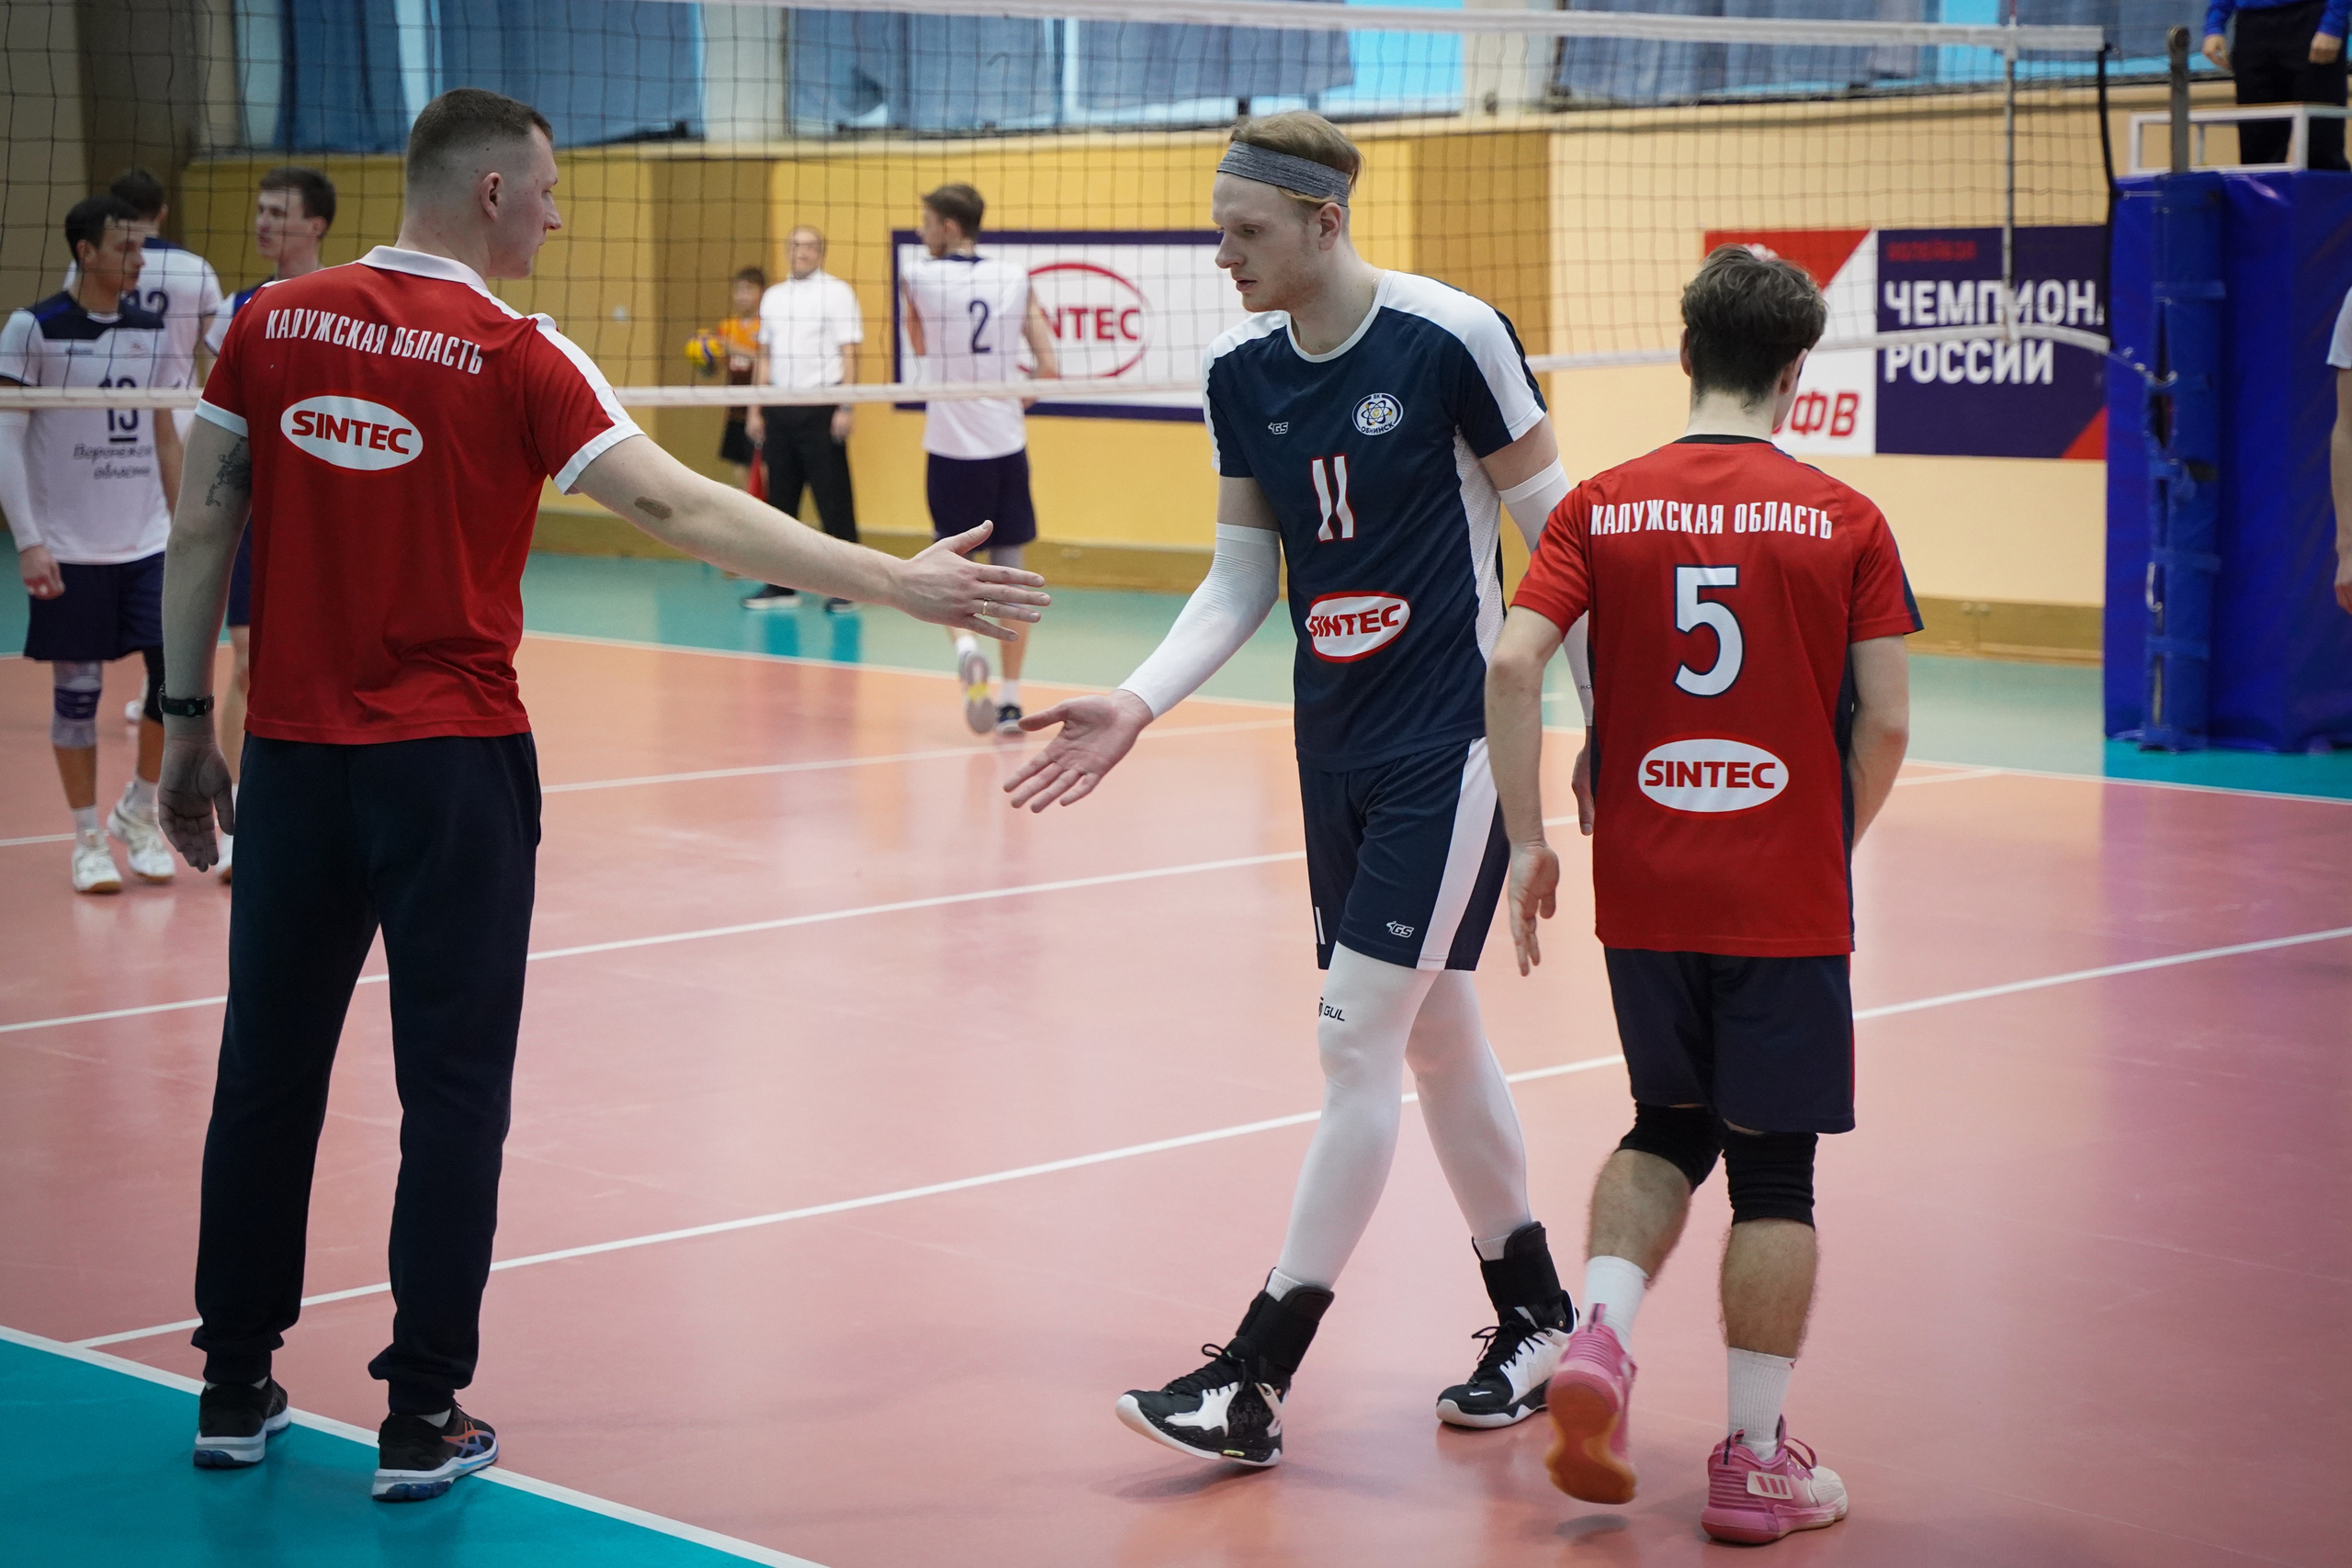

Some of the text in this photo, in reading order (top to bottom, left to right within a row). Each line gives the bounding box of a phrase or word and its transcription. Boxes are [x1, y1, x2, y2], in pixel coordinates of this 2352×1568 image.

[1040, 306, 1141, 342] NTEC
[1884, 278, 2105, 325] ЧЕМПИОН
[265, 309, 483, 375] КАЛУЖСКАЯ ОБЛАСТЬ
[969, 299, 991, 354] 2
[1884, 338, 2054, 385] РОССИИ
[291, 410, 413, 455] SINTEC
[1771, 390, 1860, 437] ФВ
[1311, 454, 1356, 542] 11
[1590, 499, 1833, 540] КАЛУЖСКАЯ ОБЛАСТЬ
[1308, 604, 1402, 637] SINTEC
[1674, 564, 1744, 699] 5
[1645, 760, 1776, 790] SINTEC
